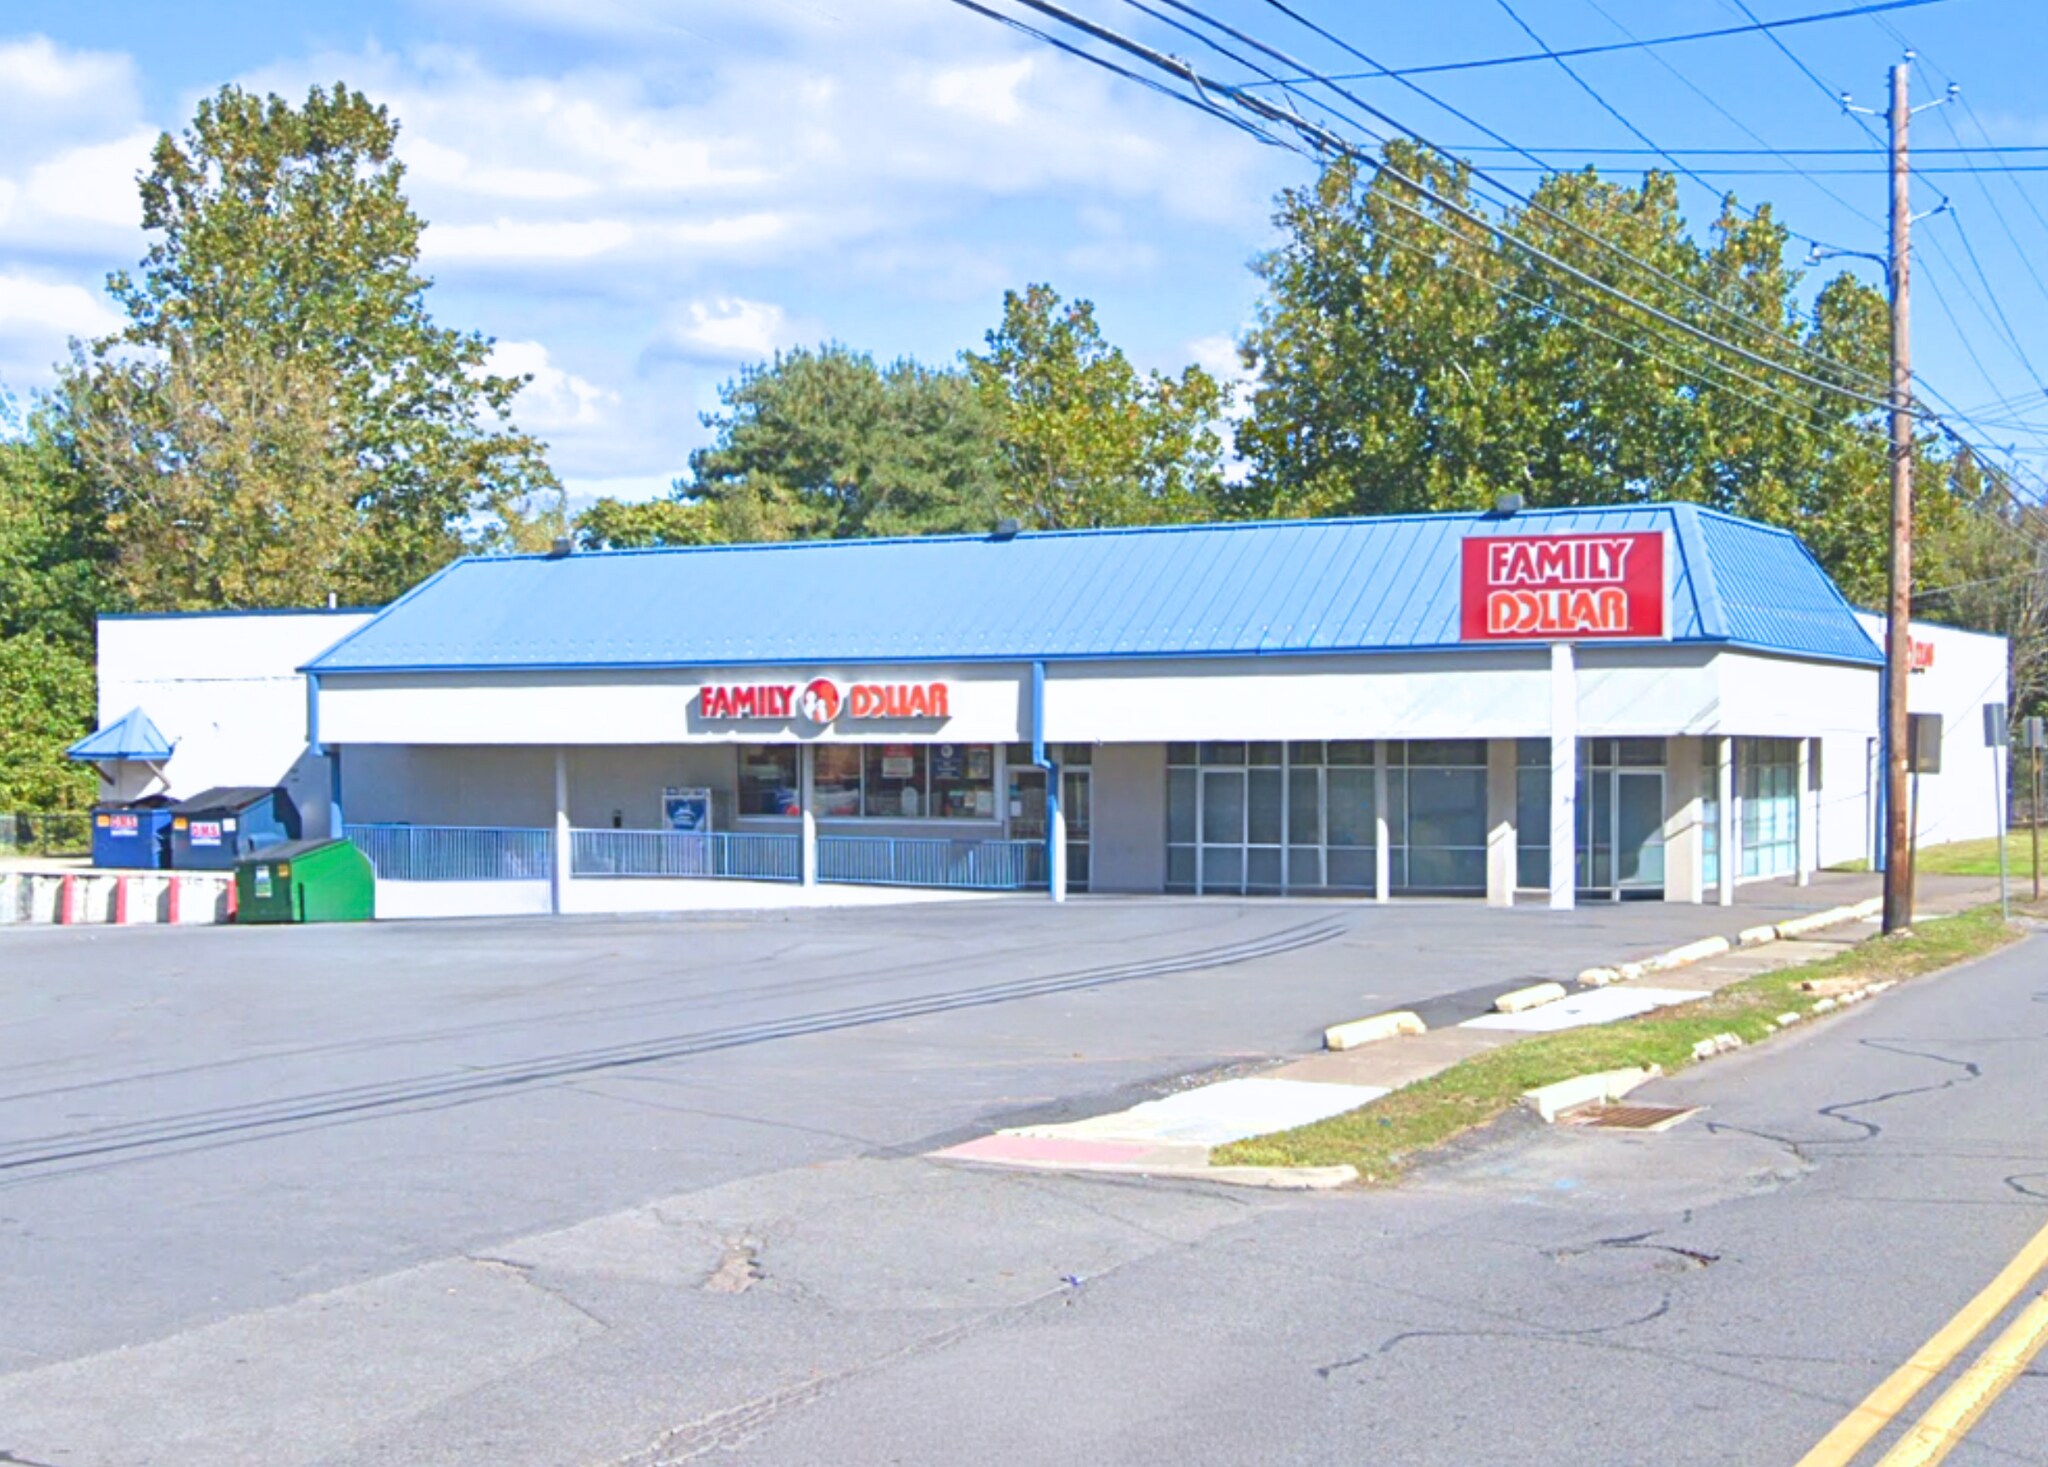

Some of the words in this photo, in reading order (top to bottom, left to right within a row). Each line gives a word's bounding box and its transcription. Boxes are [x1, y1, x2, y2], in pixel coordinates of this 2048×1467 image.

[1488, 539, 1633, 584] FAMILY
[1488, 587, 1627, 633] DOLLAR
[700, 686, 796, 717] FAMILY
[851, 683, 949, 716] DOLLAR
